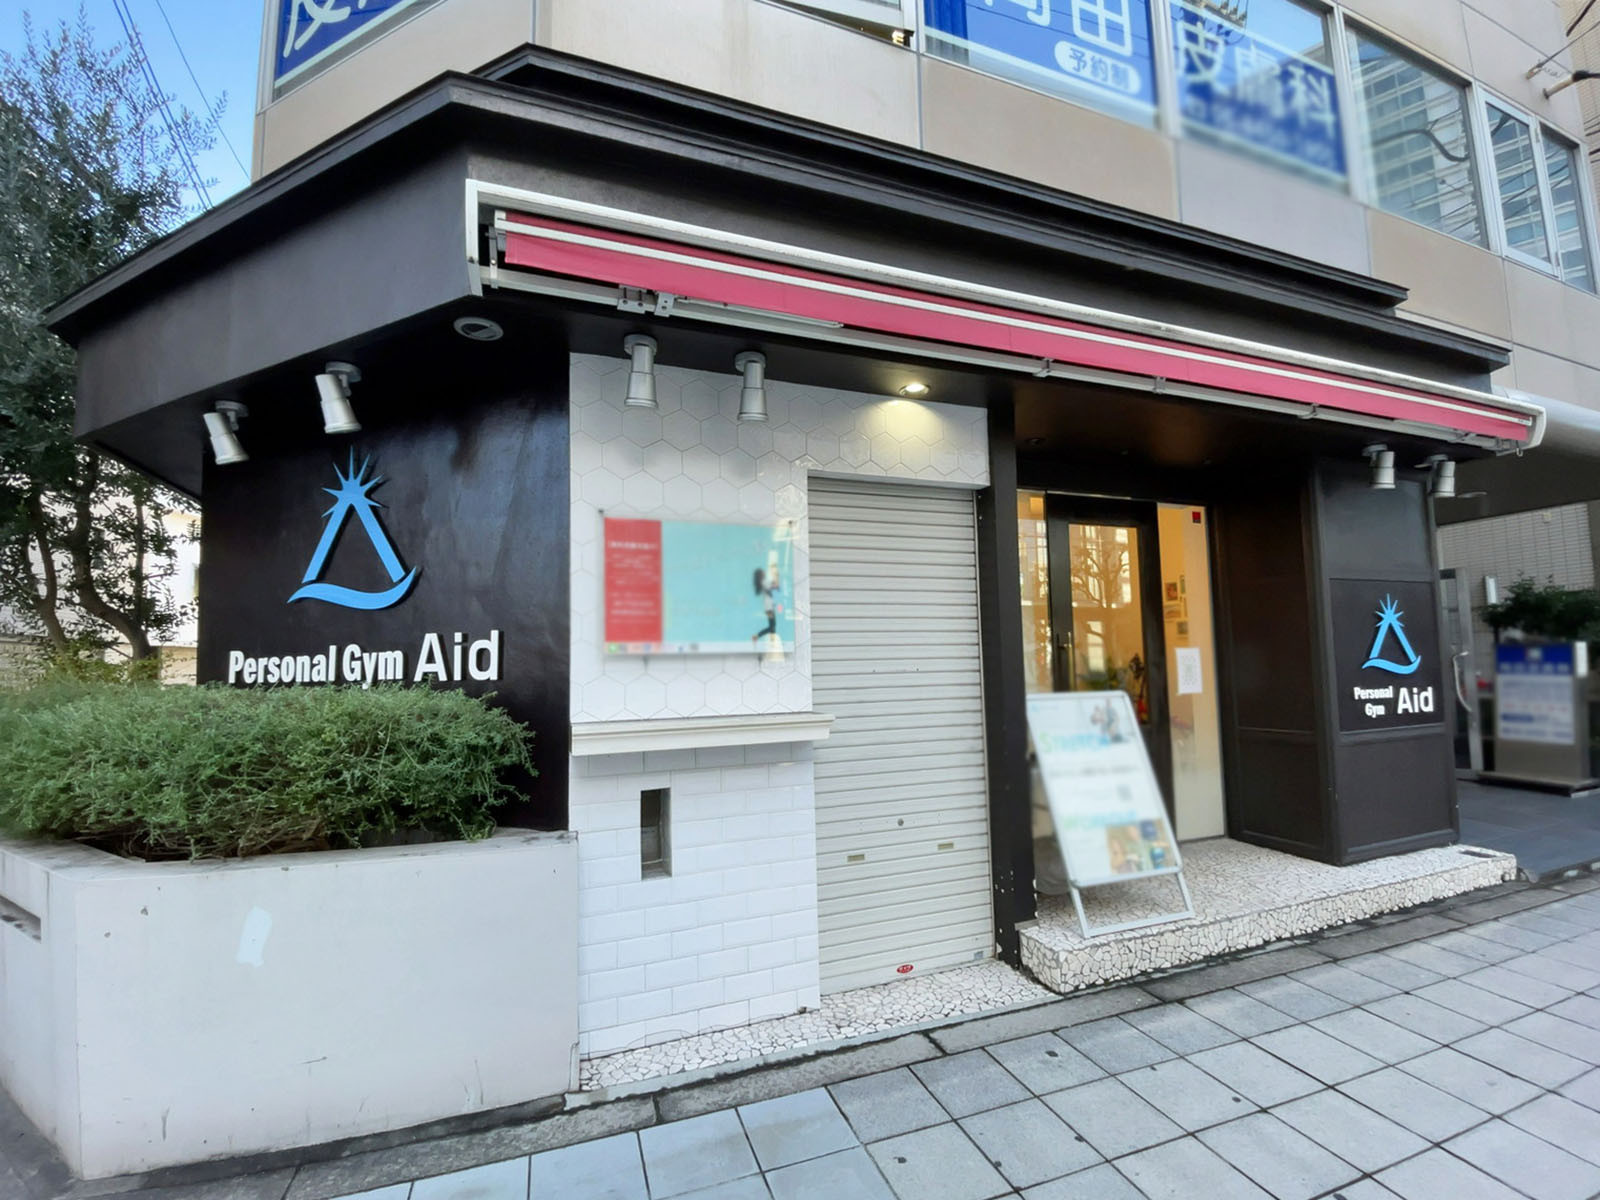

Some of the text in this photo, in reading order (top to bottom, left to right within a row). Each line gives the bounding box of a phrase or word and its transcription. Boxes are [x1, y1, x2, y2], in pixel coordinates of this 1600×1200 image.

[228, 630, 499, 690] Personal Gym Aid
[1353, 685, 1393, 700] Personal
[1397, 686, 1434, 714] Aid
[1365, 702, 1385, 718] Gym
